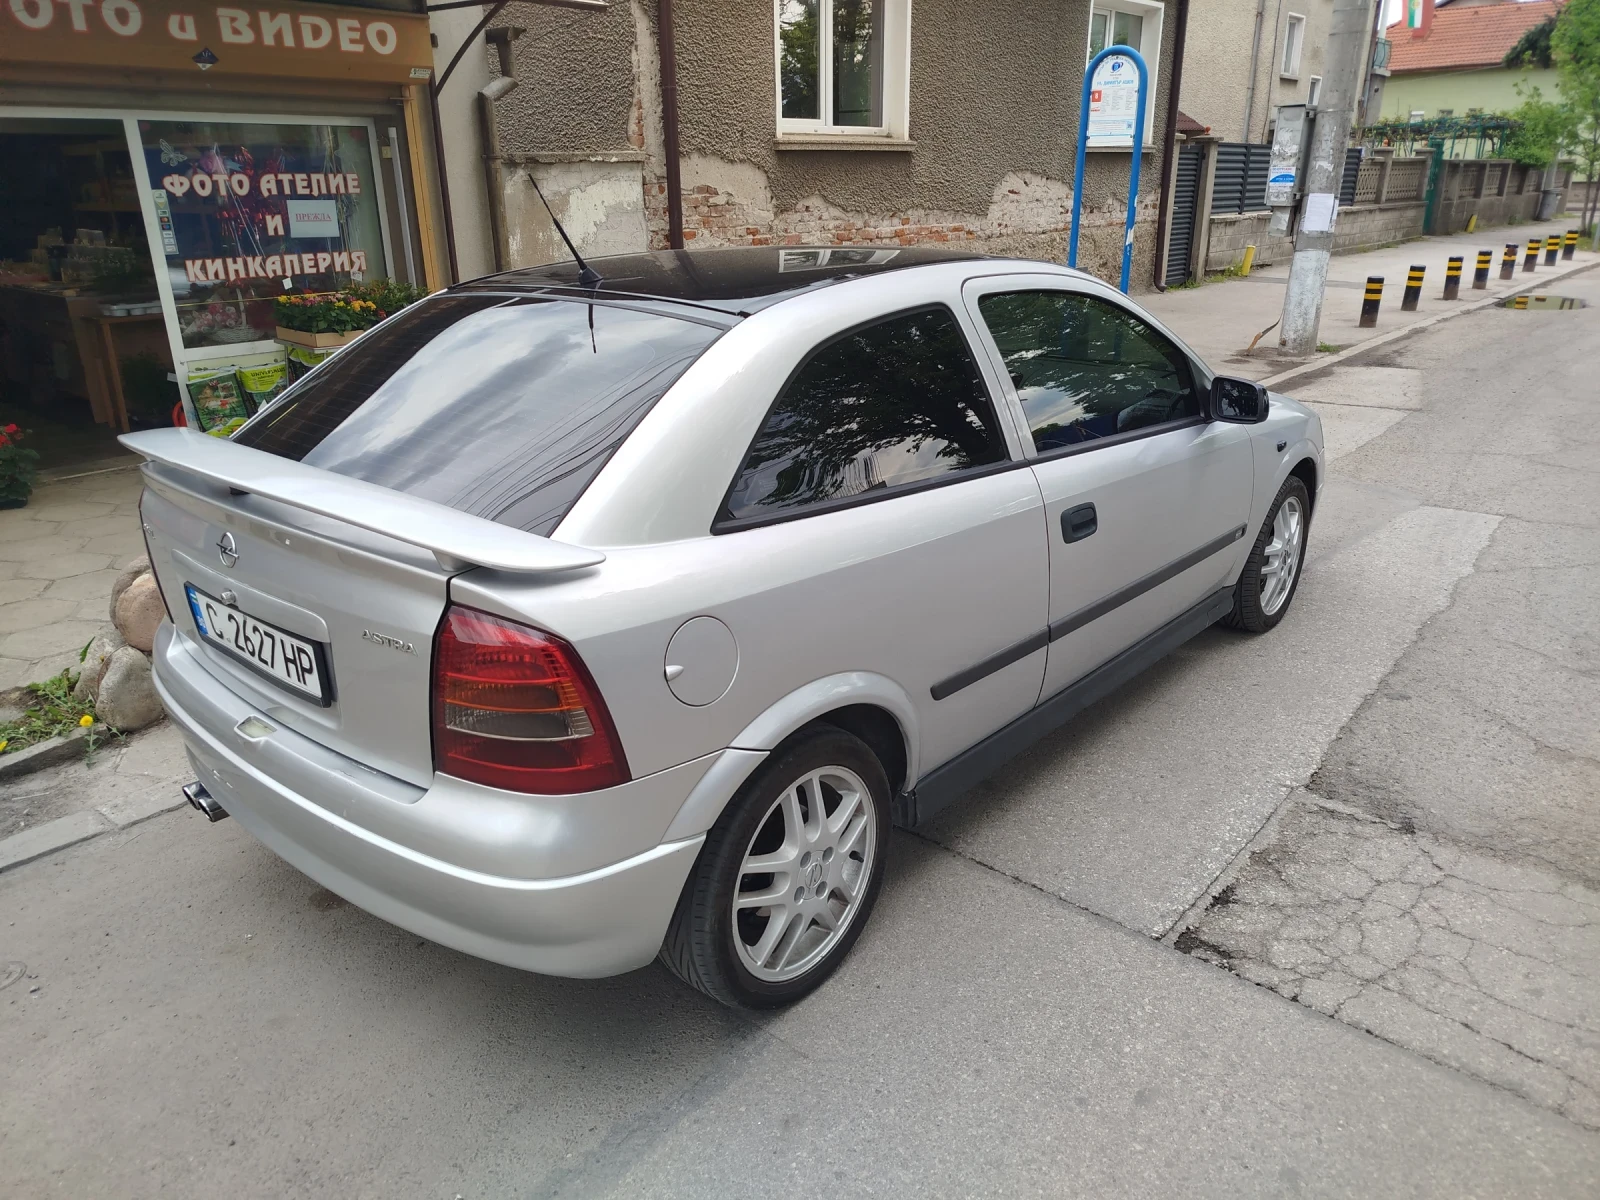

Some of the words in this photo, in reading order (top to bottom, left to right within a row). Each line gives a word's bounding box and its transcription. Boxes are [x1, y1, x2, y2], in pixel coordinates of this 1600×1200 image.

[163, 173, 250, 197] ФОТО
[260, 173, 361, 198] АТЕЛИЕ
[265, 214, 285, 237] И
[295, 213, 332, 221] ПРЕЖДА
[185, 251, 367, 282] КИНКАЛЕРИЯ
[362, 629, 419, 656] ASTRA
